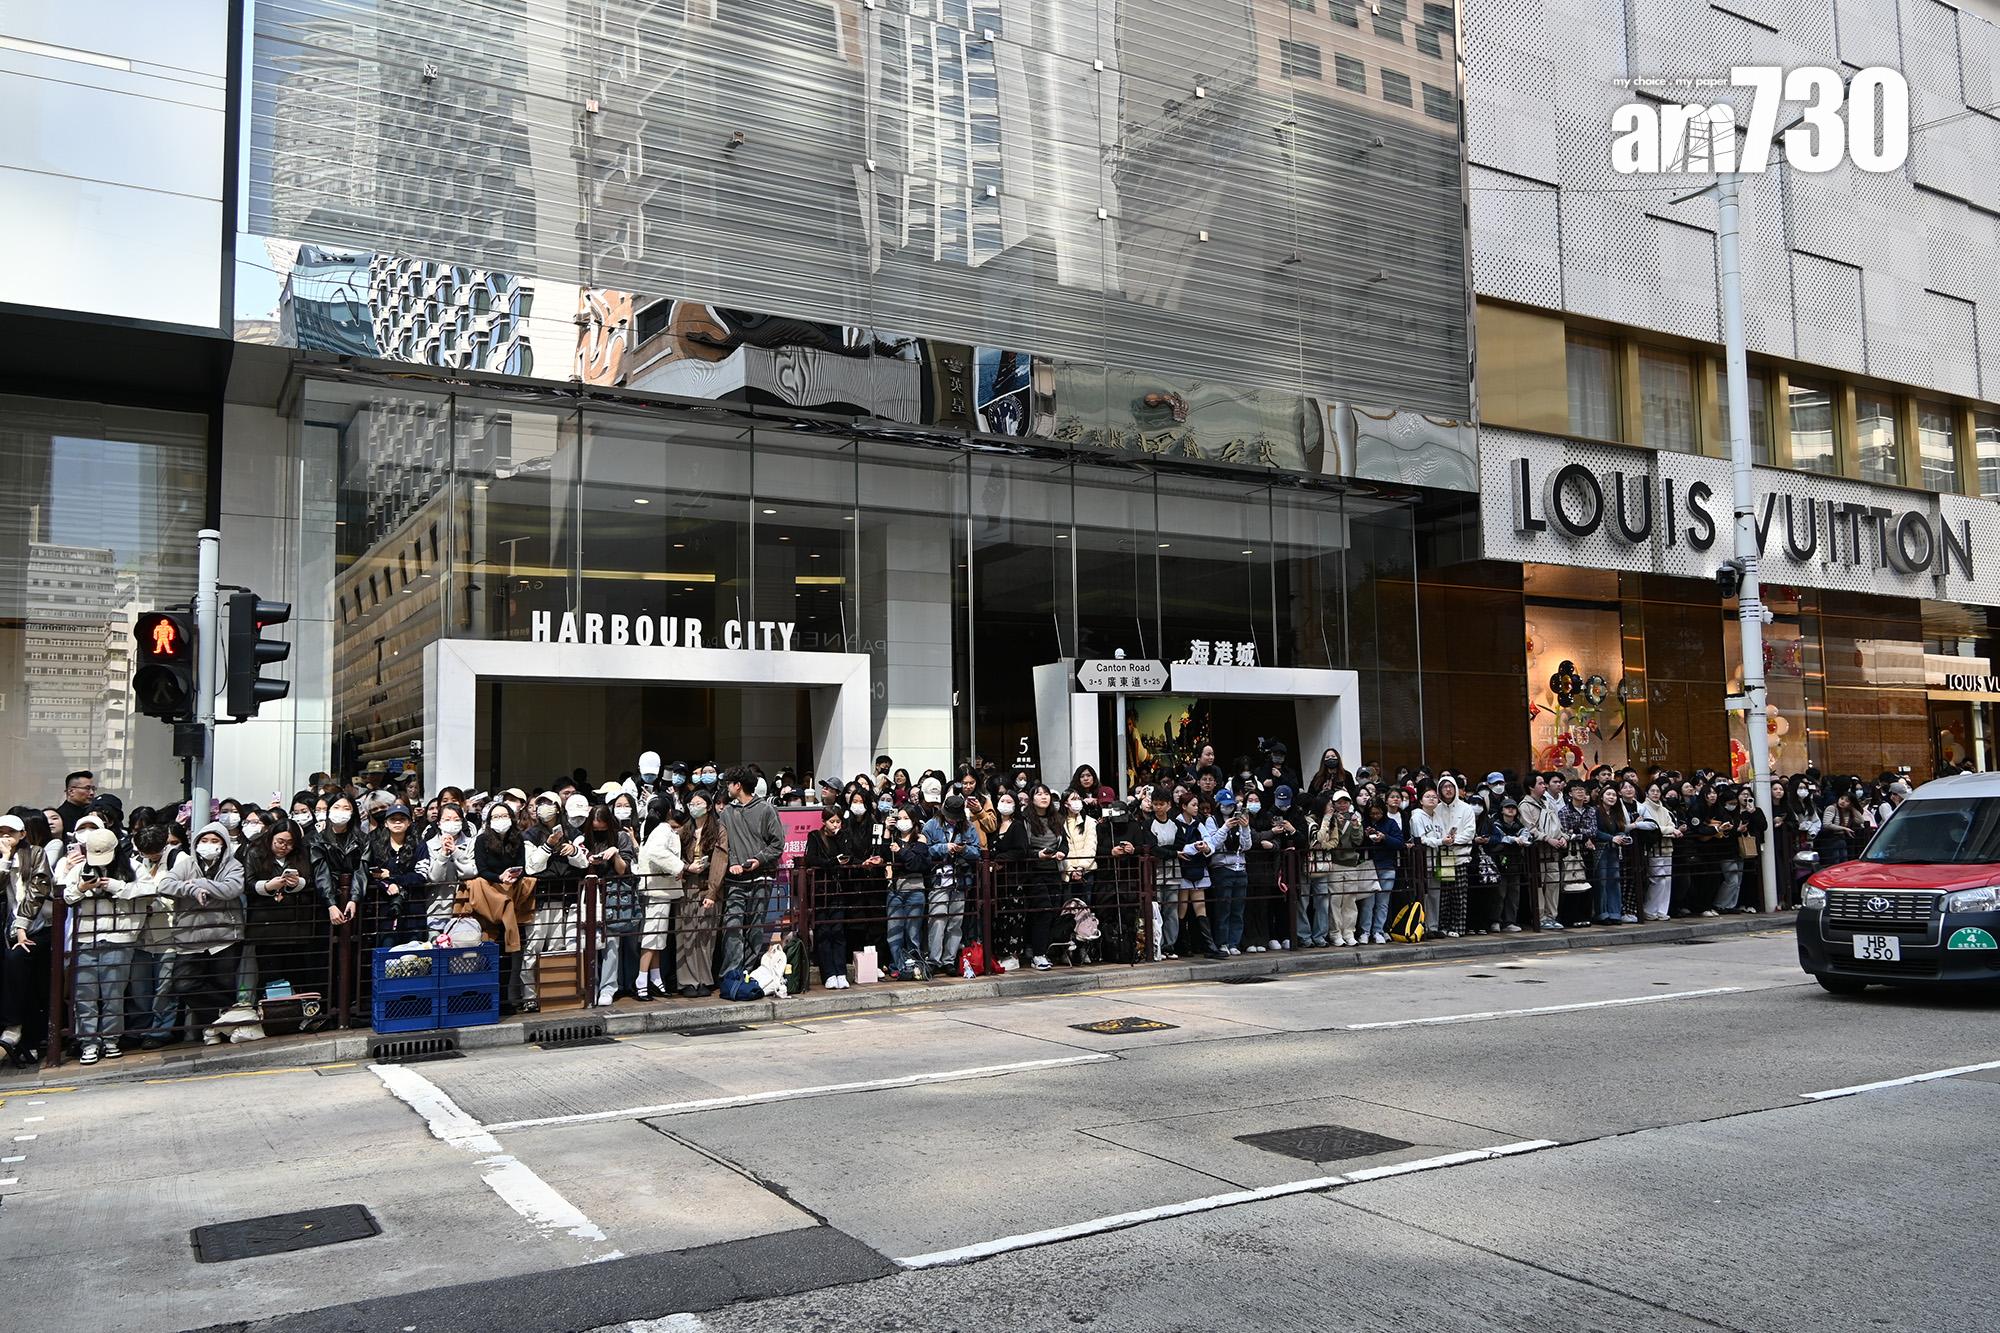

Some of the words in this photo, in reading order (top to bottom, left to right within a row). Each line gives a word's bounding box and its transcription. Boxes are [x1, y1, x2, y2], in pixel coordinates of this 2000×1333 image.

[1510, 457, 1717, 551] LOUIS
[531, 610, 703, 649] HARBOUR
[724, 618, 796, 652] CITY
[1190, 639, 1255, 666] 海港城
[1096, 662, 1127, 673] Canton
[1129, 663, 1151, 672] Road
[1107, 676, 1141, 688] 廣東道
[1949, 674, 1984, 692] LOUIS
[1018, 736, 1029, 755] 5
[1867, 935, 1887, 949] HB
[1966, 933, 1977, 943] 4
[1862, 947, 1893, 960] 350
